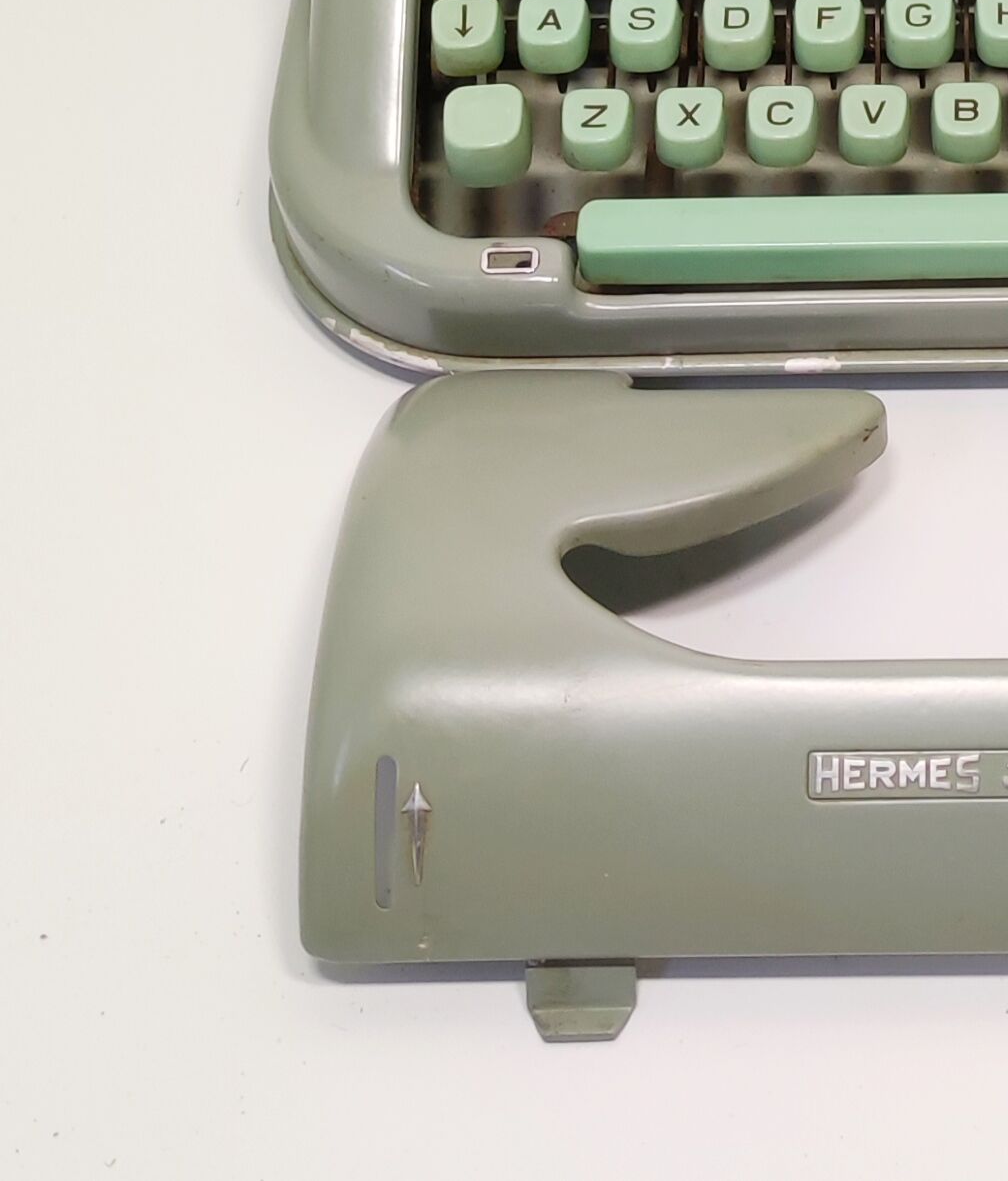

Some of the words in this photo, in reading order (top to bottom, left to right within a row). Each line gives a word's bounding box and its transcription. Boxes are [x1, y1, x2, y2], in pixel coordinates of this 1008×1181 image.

[536, 8, 562, 31] A
[627, 7, 656, 31] S
[723, 6, 750, 30] D
[816, 6, 842, 30] F
[905, 3, 932, 28] G
[580, 104, 609, 129] Z
[676, 102, 702, 127] X
[766, 100, 794, 126] C
[862, 100, 887, 125] V
[954, 98, 979, 122] B
[814, 753, 980, 794] HERMES
